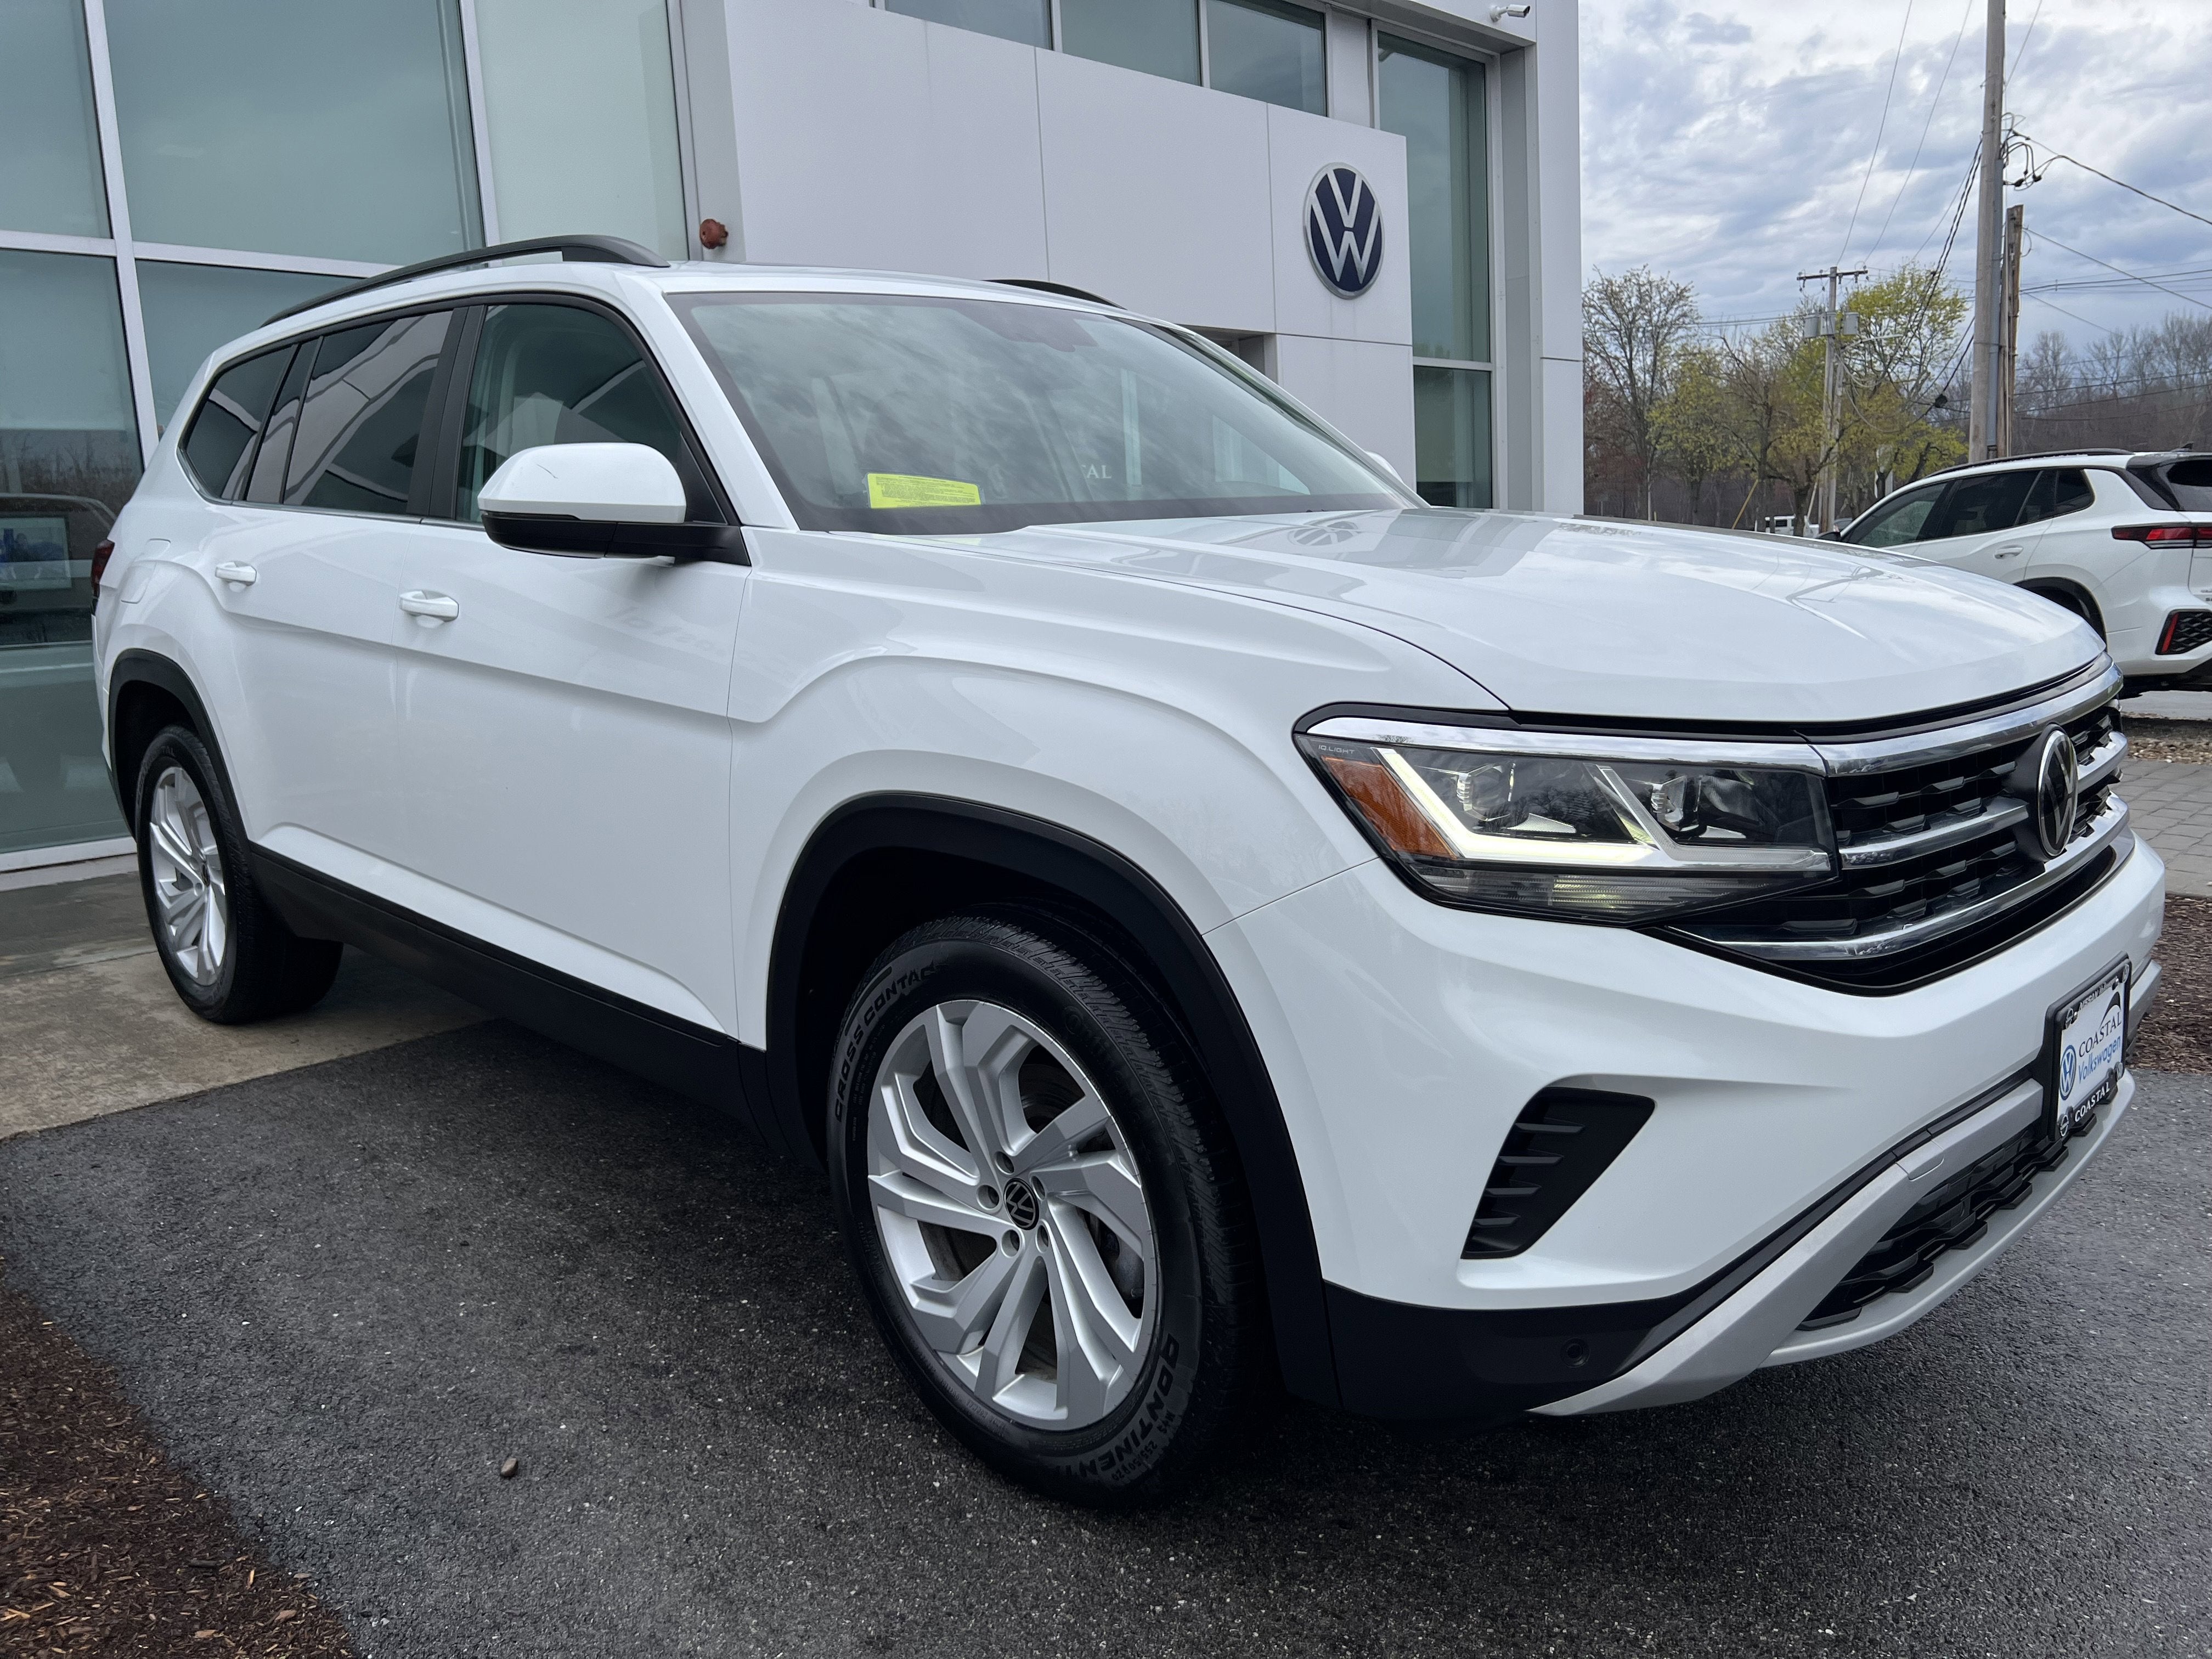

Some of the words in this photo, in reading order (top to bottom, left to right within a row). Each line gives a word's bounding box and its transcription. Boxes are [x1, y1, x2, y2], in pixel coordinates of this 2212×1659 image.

[1307, 164, 1383, 294] VW
[1318, 744, 1355, 754] IQ.LIGHT
[2078, 1035, 2121, 1085] Volkswagen
[2079, 1012, 2122, 1058] COASTAL
[834, 1023, 865, 1122] CROSS
[2060, 1045, 2076, 1100] VW
[2074, 1081, 2111, 1123] COASTAL
[1004, 1181, 1036, 1229] VW
[1066, 1333, 1180, 1477] CONTINEN
